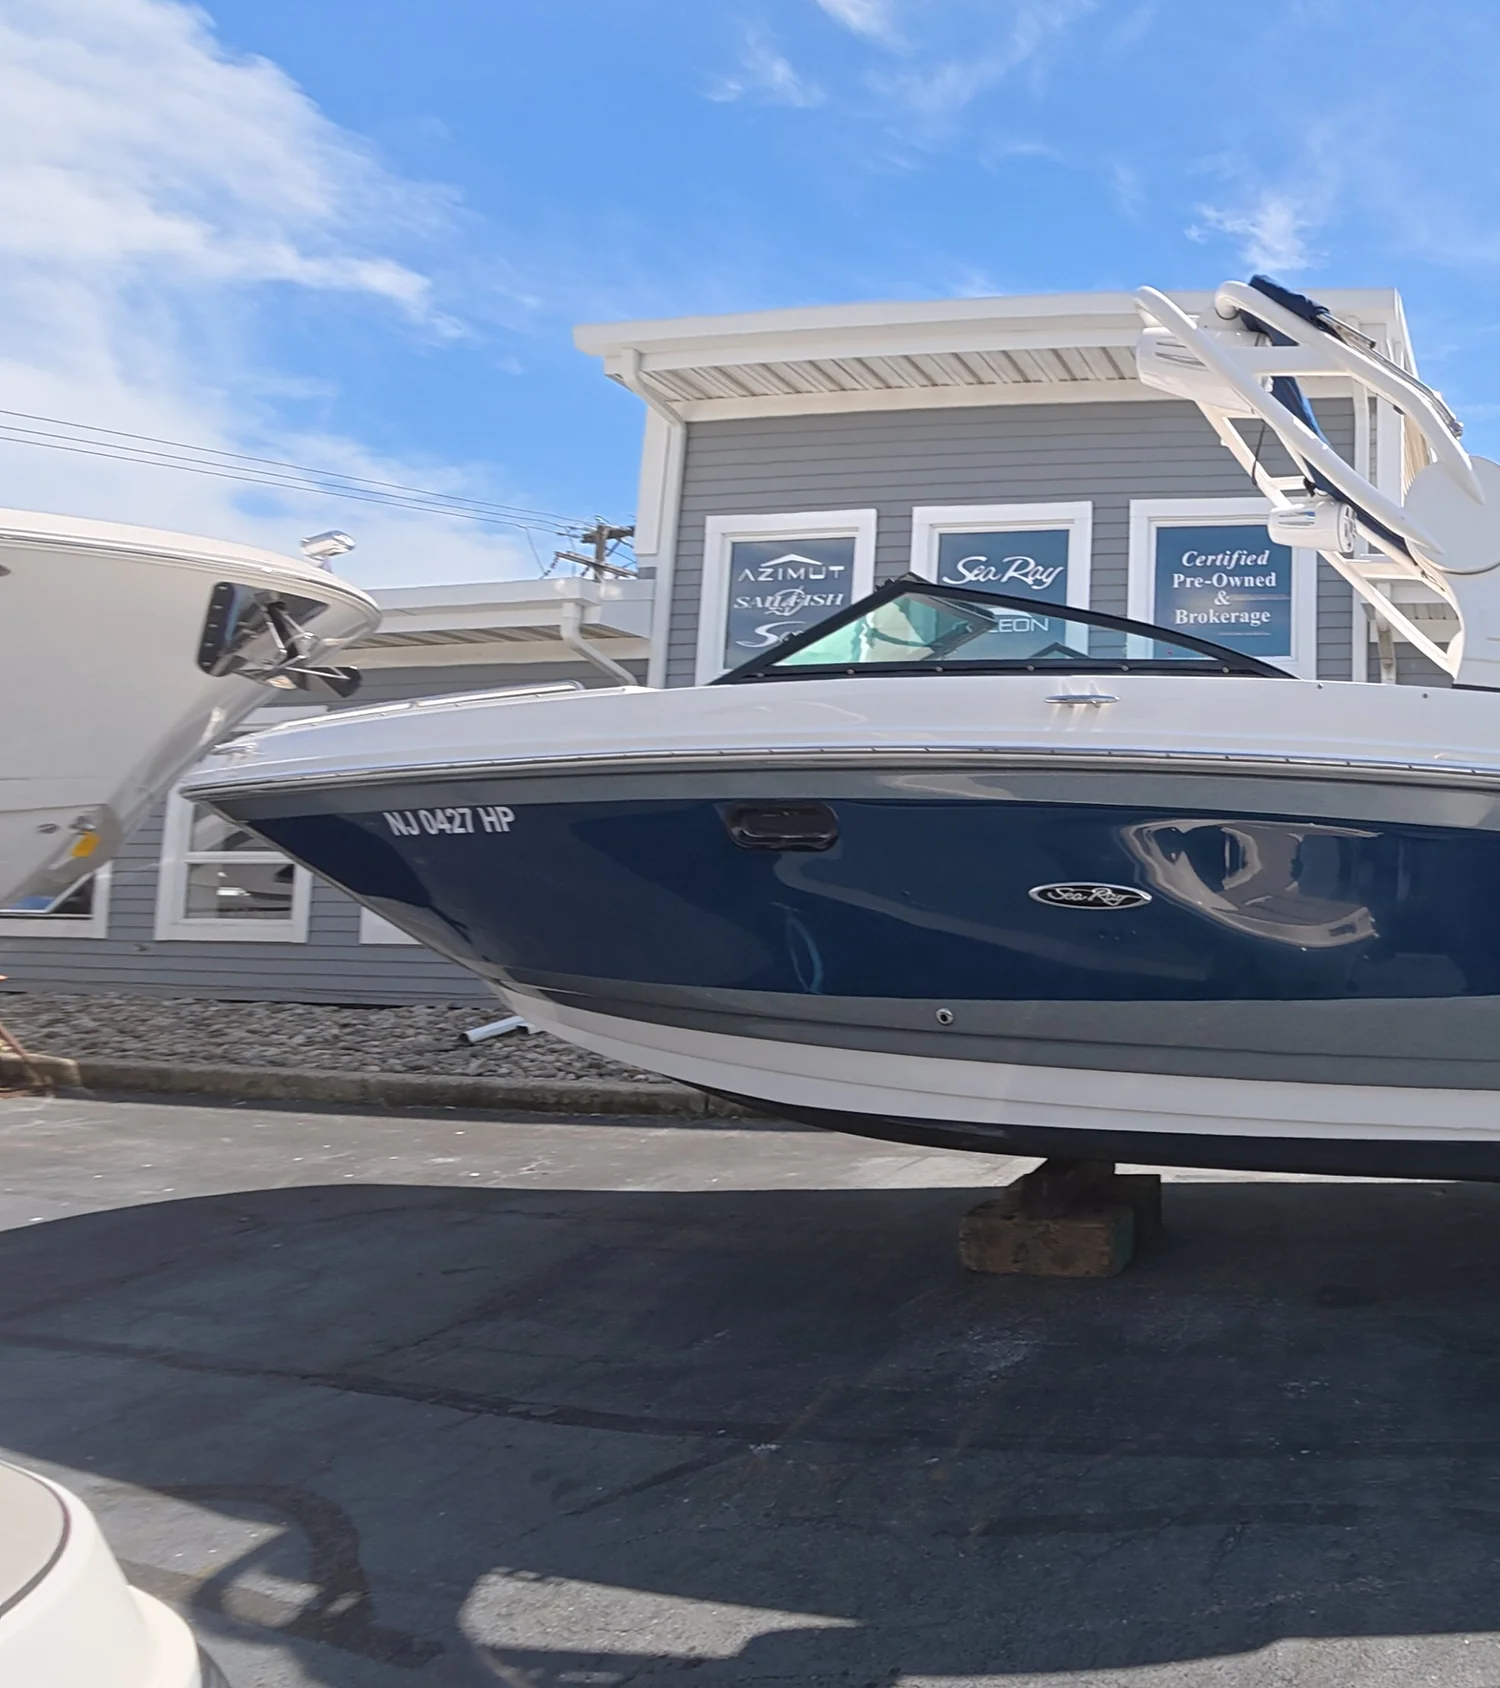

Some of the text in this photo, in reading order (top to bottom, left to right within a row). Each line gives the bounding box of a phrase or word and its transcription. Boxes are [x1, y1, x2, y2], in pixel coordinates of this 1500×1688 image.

[1181, 549, 1271, 570] Certified
[738, 565, 845, 582] AZIMUT
[942, 556, 1064, 590] Sea Ray
[1172, 572, 1277, 588] Pre-Owned
[1213, 590, 1231, 606] &
[988, 617, 1049, 633] EON
[1174, 609, 1272, 627] Brokerage
[382, 806, 516, 836] NJ 0427 HP
[1047, 887, 1129, 906] Sea Ray
